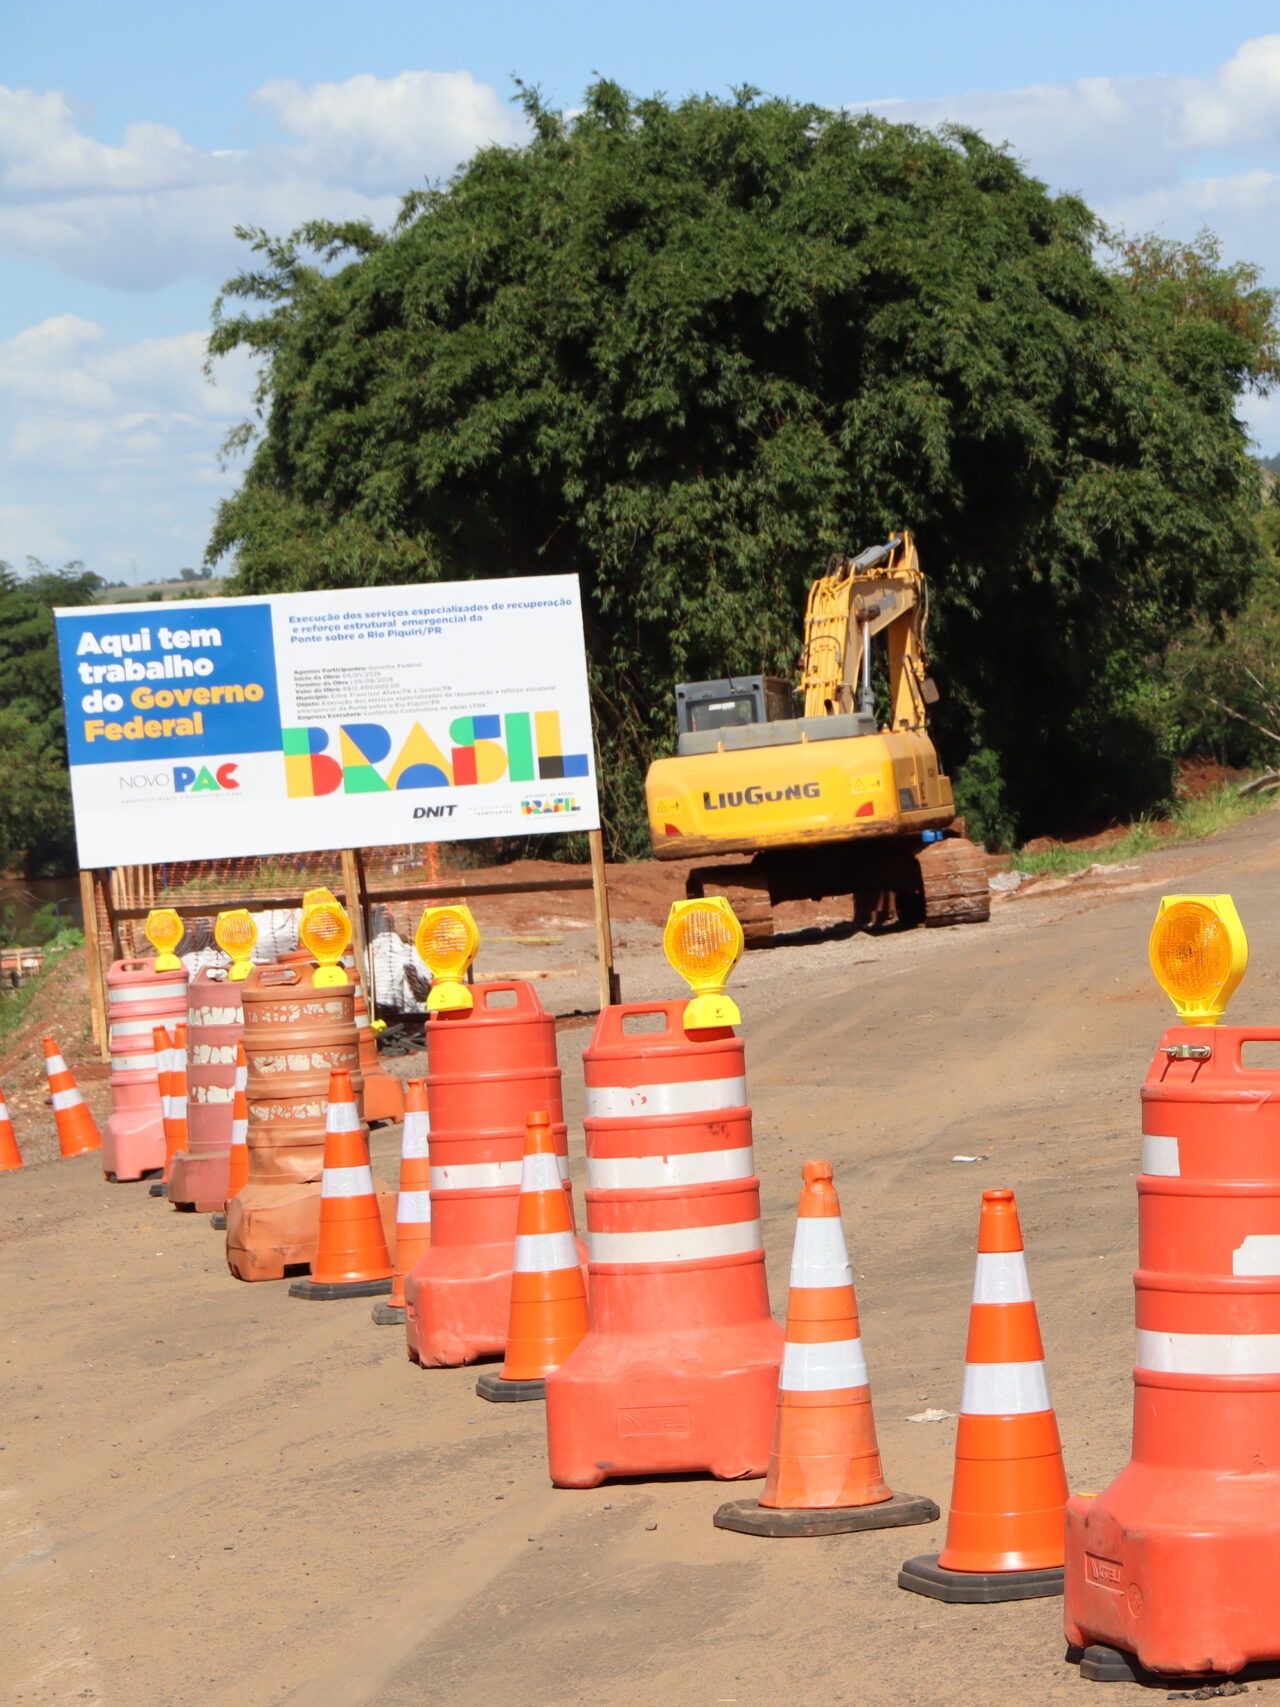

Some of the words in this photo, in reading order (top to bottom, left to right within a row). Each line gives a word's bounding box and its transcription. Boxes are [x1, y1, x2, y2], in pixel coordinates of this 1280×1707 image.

[289, 612, 340, 624] Execução
[343, 612, 362, 620] dos
[365, 609, 409, 620] serviços
[412, 605, 489, 616] especializados
[491, 603, 505, 611] de
[507, 598, 572, 610] recuperação
[302, 622, 340, 632] reforço
[344, 620, 397, 630] estrutural
[402, 615, 467, 626] emergencial
[470, 614, 483, 622] da
[76, 628, 152, 657] Aqui
[158, 627, 222, 650] tem
[290, 634, 322, 644] Ponte
[325, 631, 355, 642] sobre
[358, 632, 365, 640] o
[368, 630, 384, 640] Rio
[388, 626, 442, 638] Piquiri/PR
[78, 654, 214, 684] trabalho
[82, 689, 124, 713] do
[131, 683, 264, 709] Governo
[85, 711, 204, 742] Federal
[282, 710, 589, 799] BRASIL
[120, 772, 170, 790] NOVO
[173, 762, 240, 793] PAC
[413, 804, 458, 819] DNIT
[520, 797, 581, 816] BRASIL
